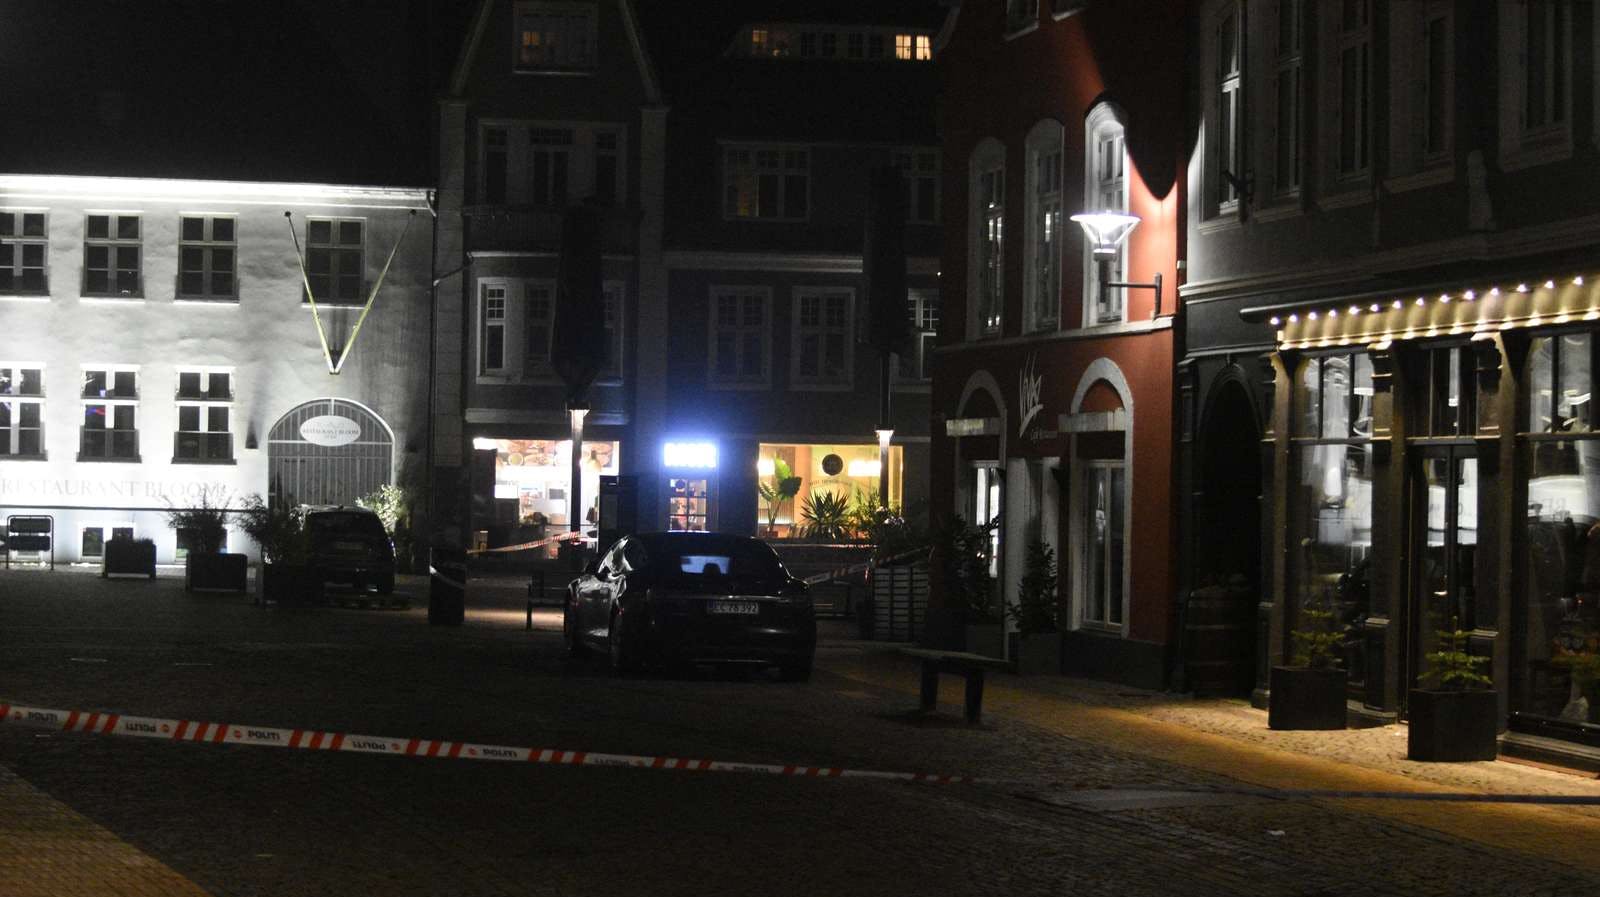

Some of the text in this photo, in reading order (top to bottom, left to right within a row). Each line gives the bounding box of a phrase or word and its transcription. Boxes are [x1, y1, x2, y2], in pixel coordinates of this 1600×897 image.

[1, 478, 141, 497] RESTAURANT
[28, 711, 58, 721] POLITI
[125, 721, 156, 733] POLITI
[247, 729, 281, 741] POLITI
[351, 740, 387, 751] POLITI
[482, 746, 518, 758] POLITI
